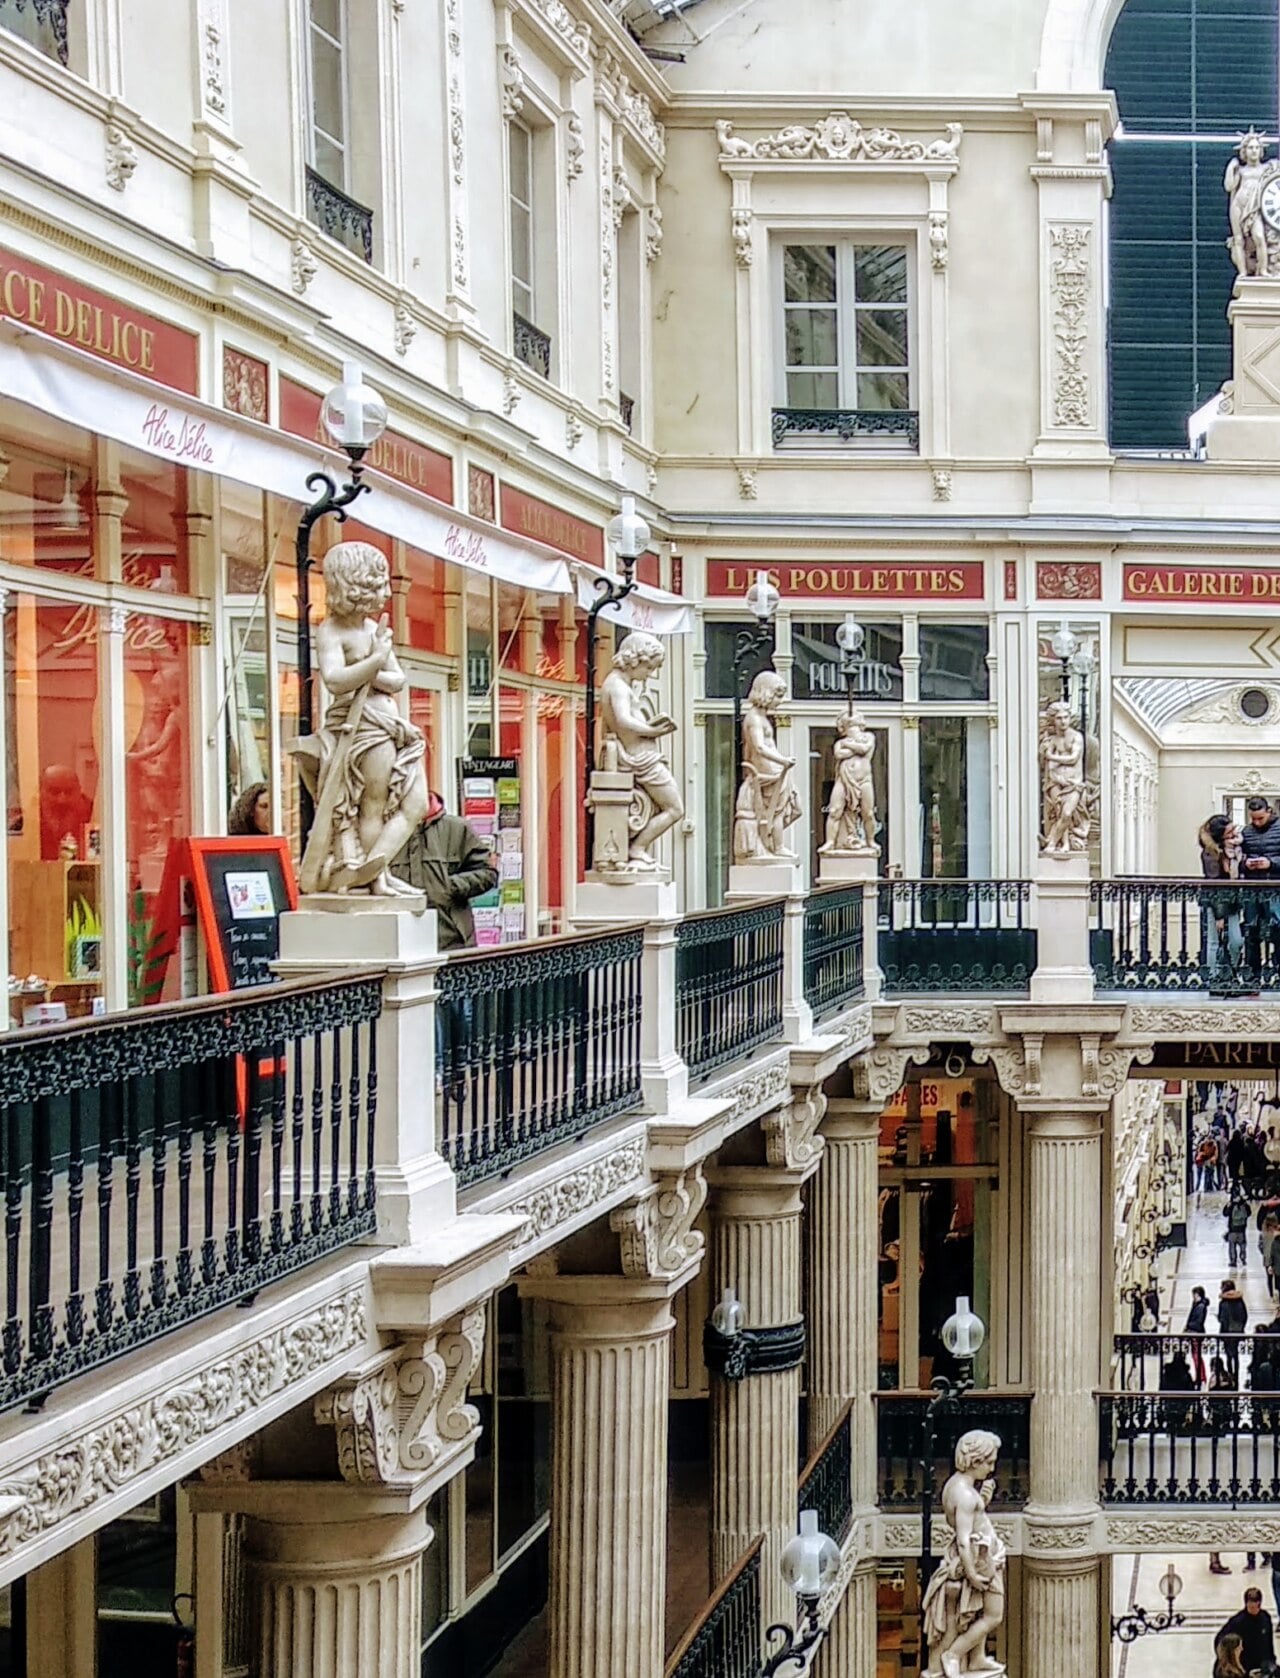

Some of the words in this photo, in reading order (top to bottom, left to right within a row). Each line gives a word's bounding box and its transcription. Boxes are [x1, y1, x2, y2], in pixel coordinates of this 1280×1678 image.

[0, 266, 46, 327] CE
[56, 288, 155, 372] DELICE
[142, 404, 176, 450] Alice
[176, 415, 214, 464] Délice
[372, 438, 427, 487] DELICE
[789, 569, 965, 592] POULETTES
[1127, 570, 1244, 596] GALERIE
[945, 1048, 966, 1077] 6
